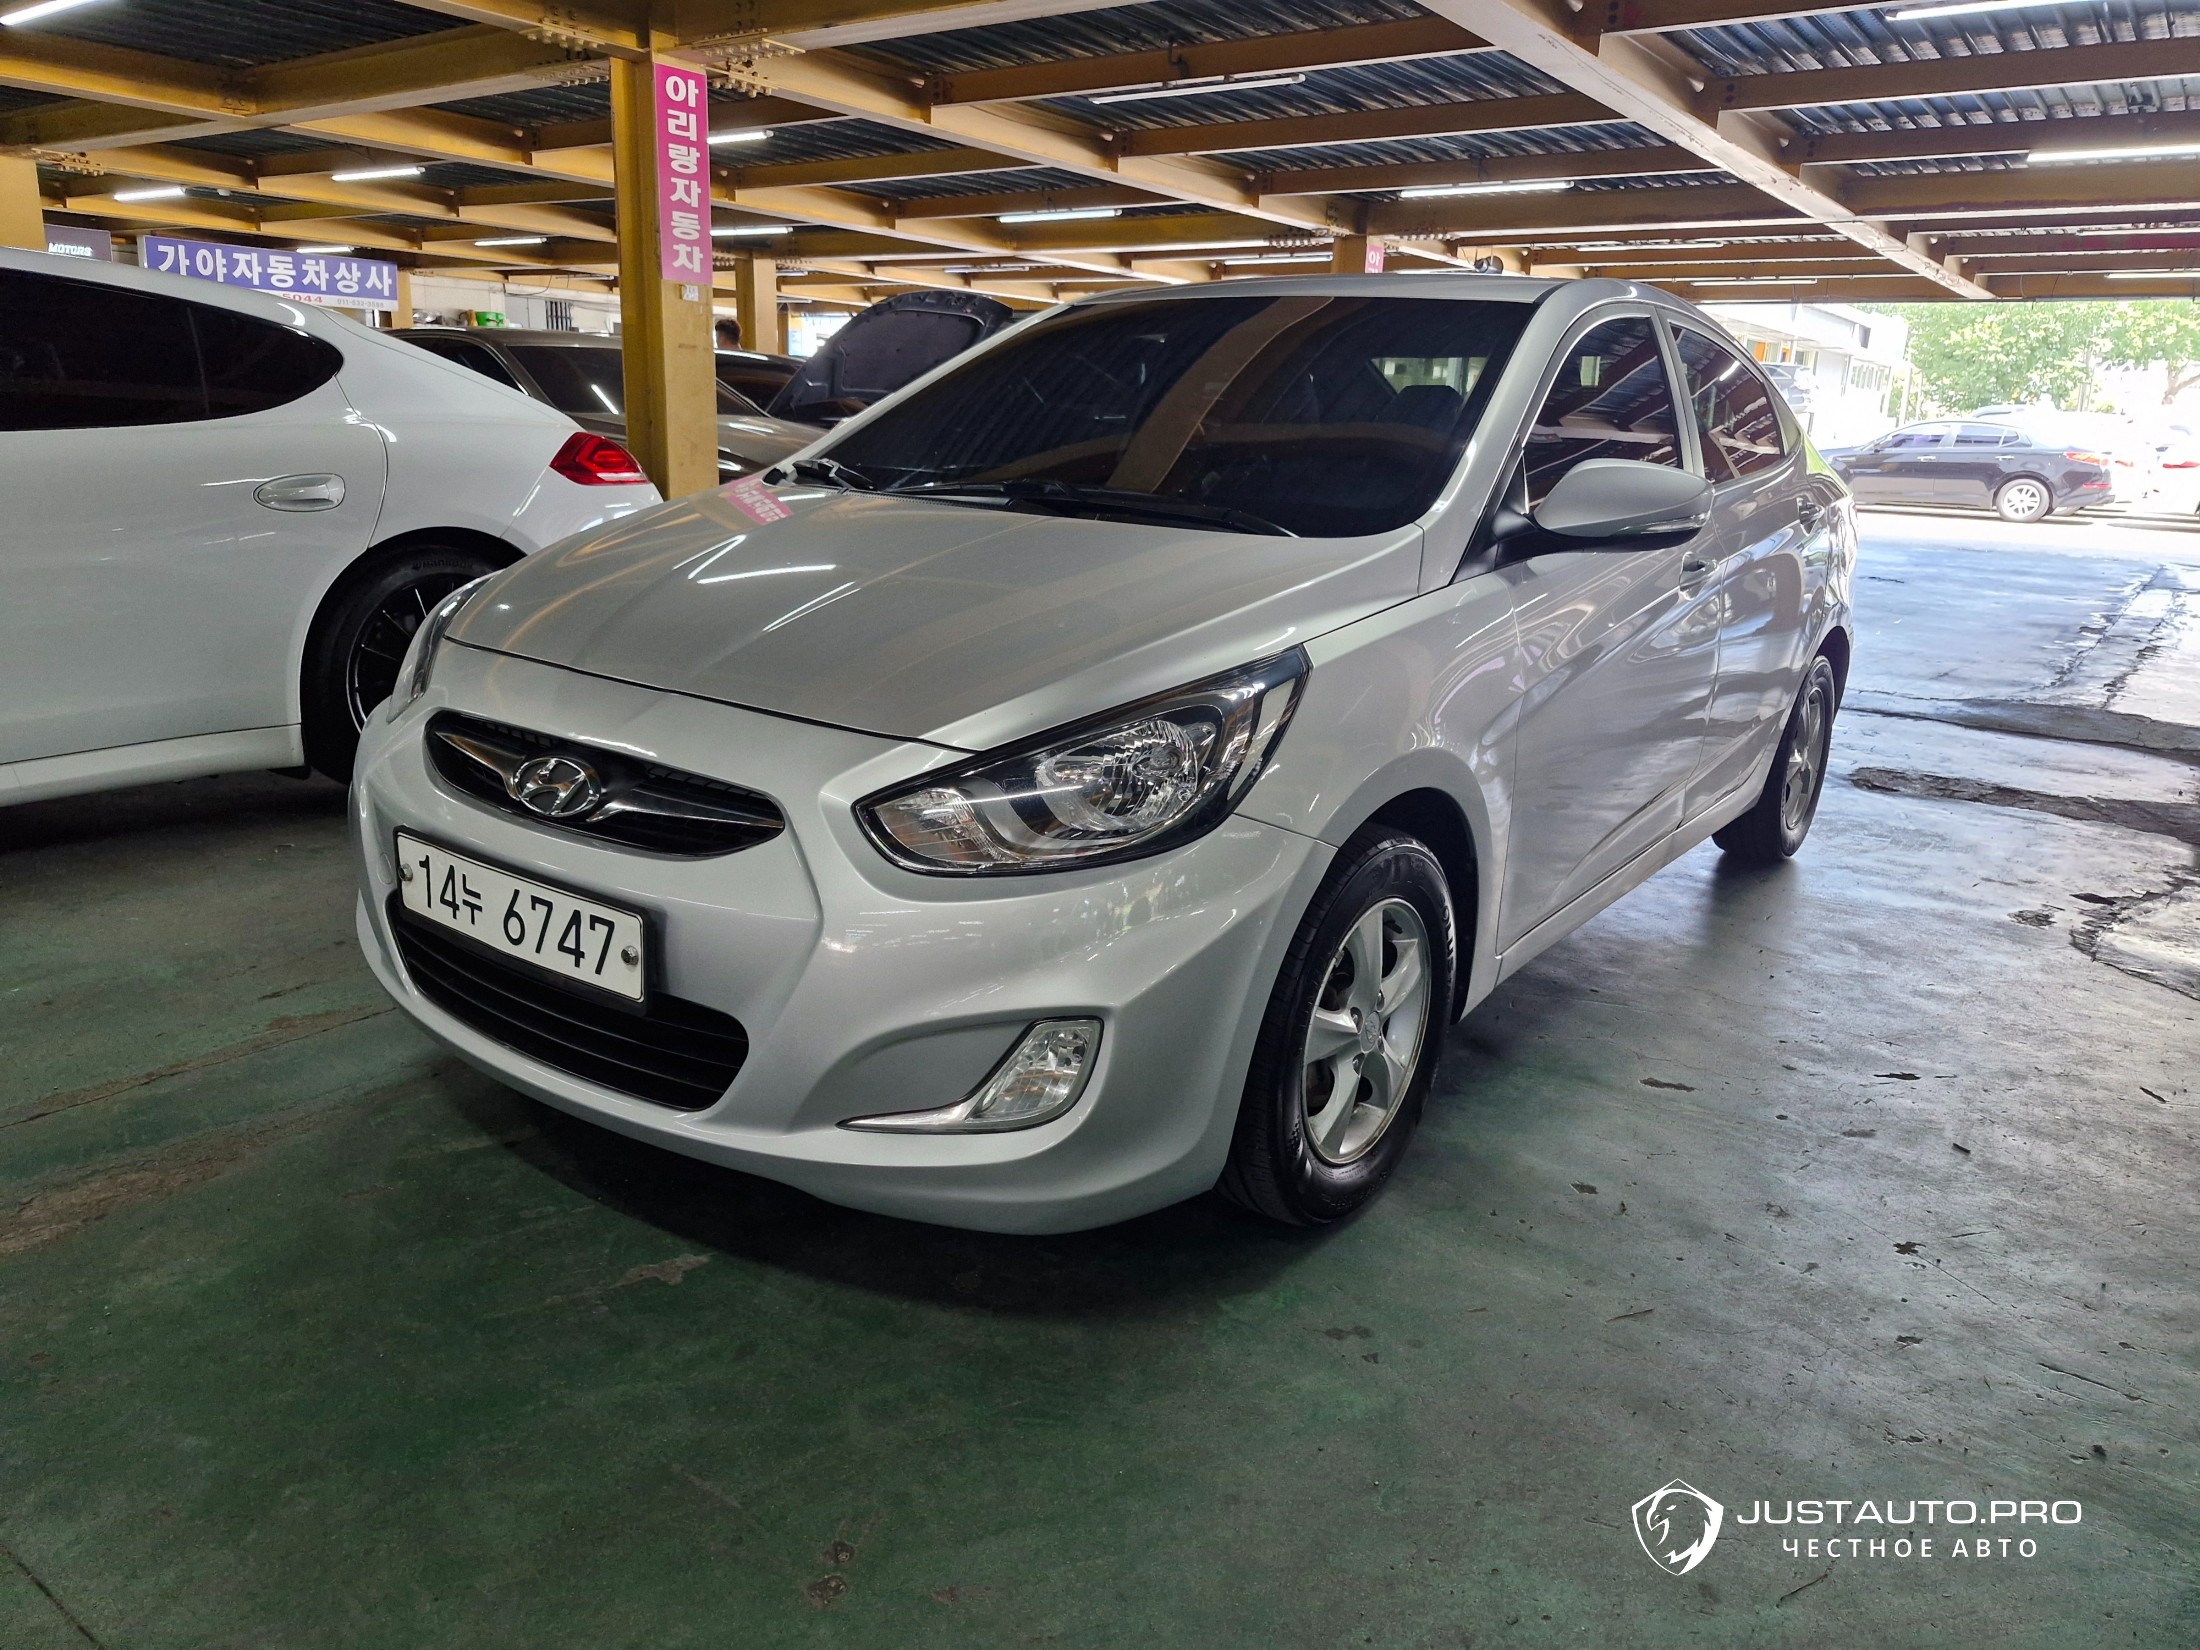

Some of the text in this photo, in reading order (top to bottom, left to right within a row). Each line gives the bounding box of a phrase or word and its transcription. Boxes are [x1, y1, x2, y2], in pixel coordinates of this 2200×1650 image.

[665, 75, 704, 273] 아리랑자동차
[48, 242, 93, 257] MOTORS
[157, 245, 393, 297] 가야자동차상사
[419, 855, 615, 976] 14누 6747
